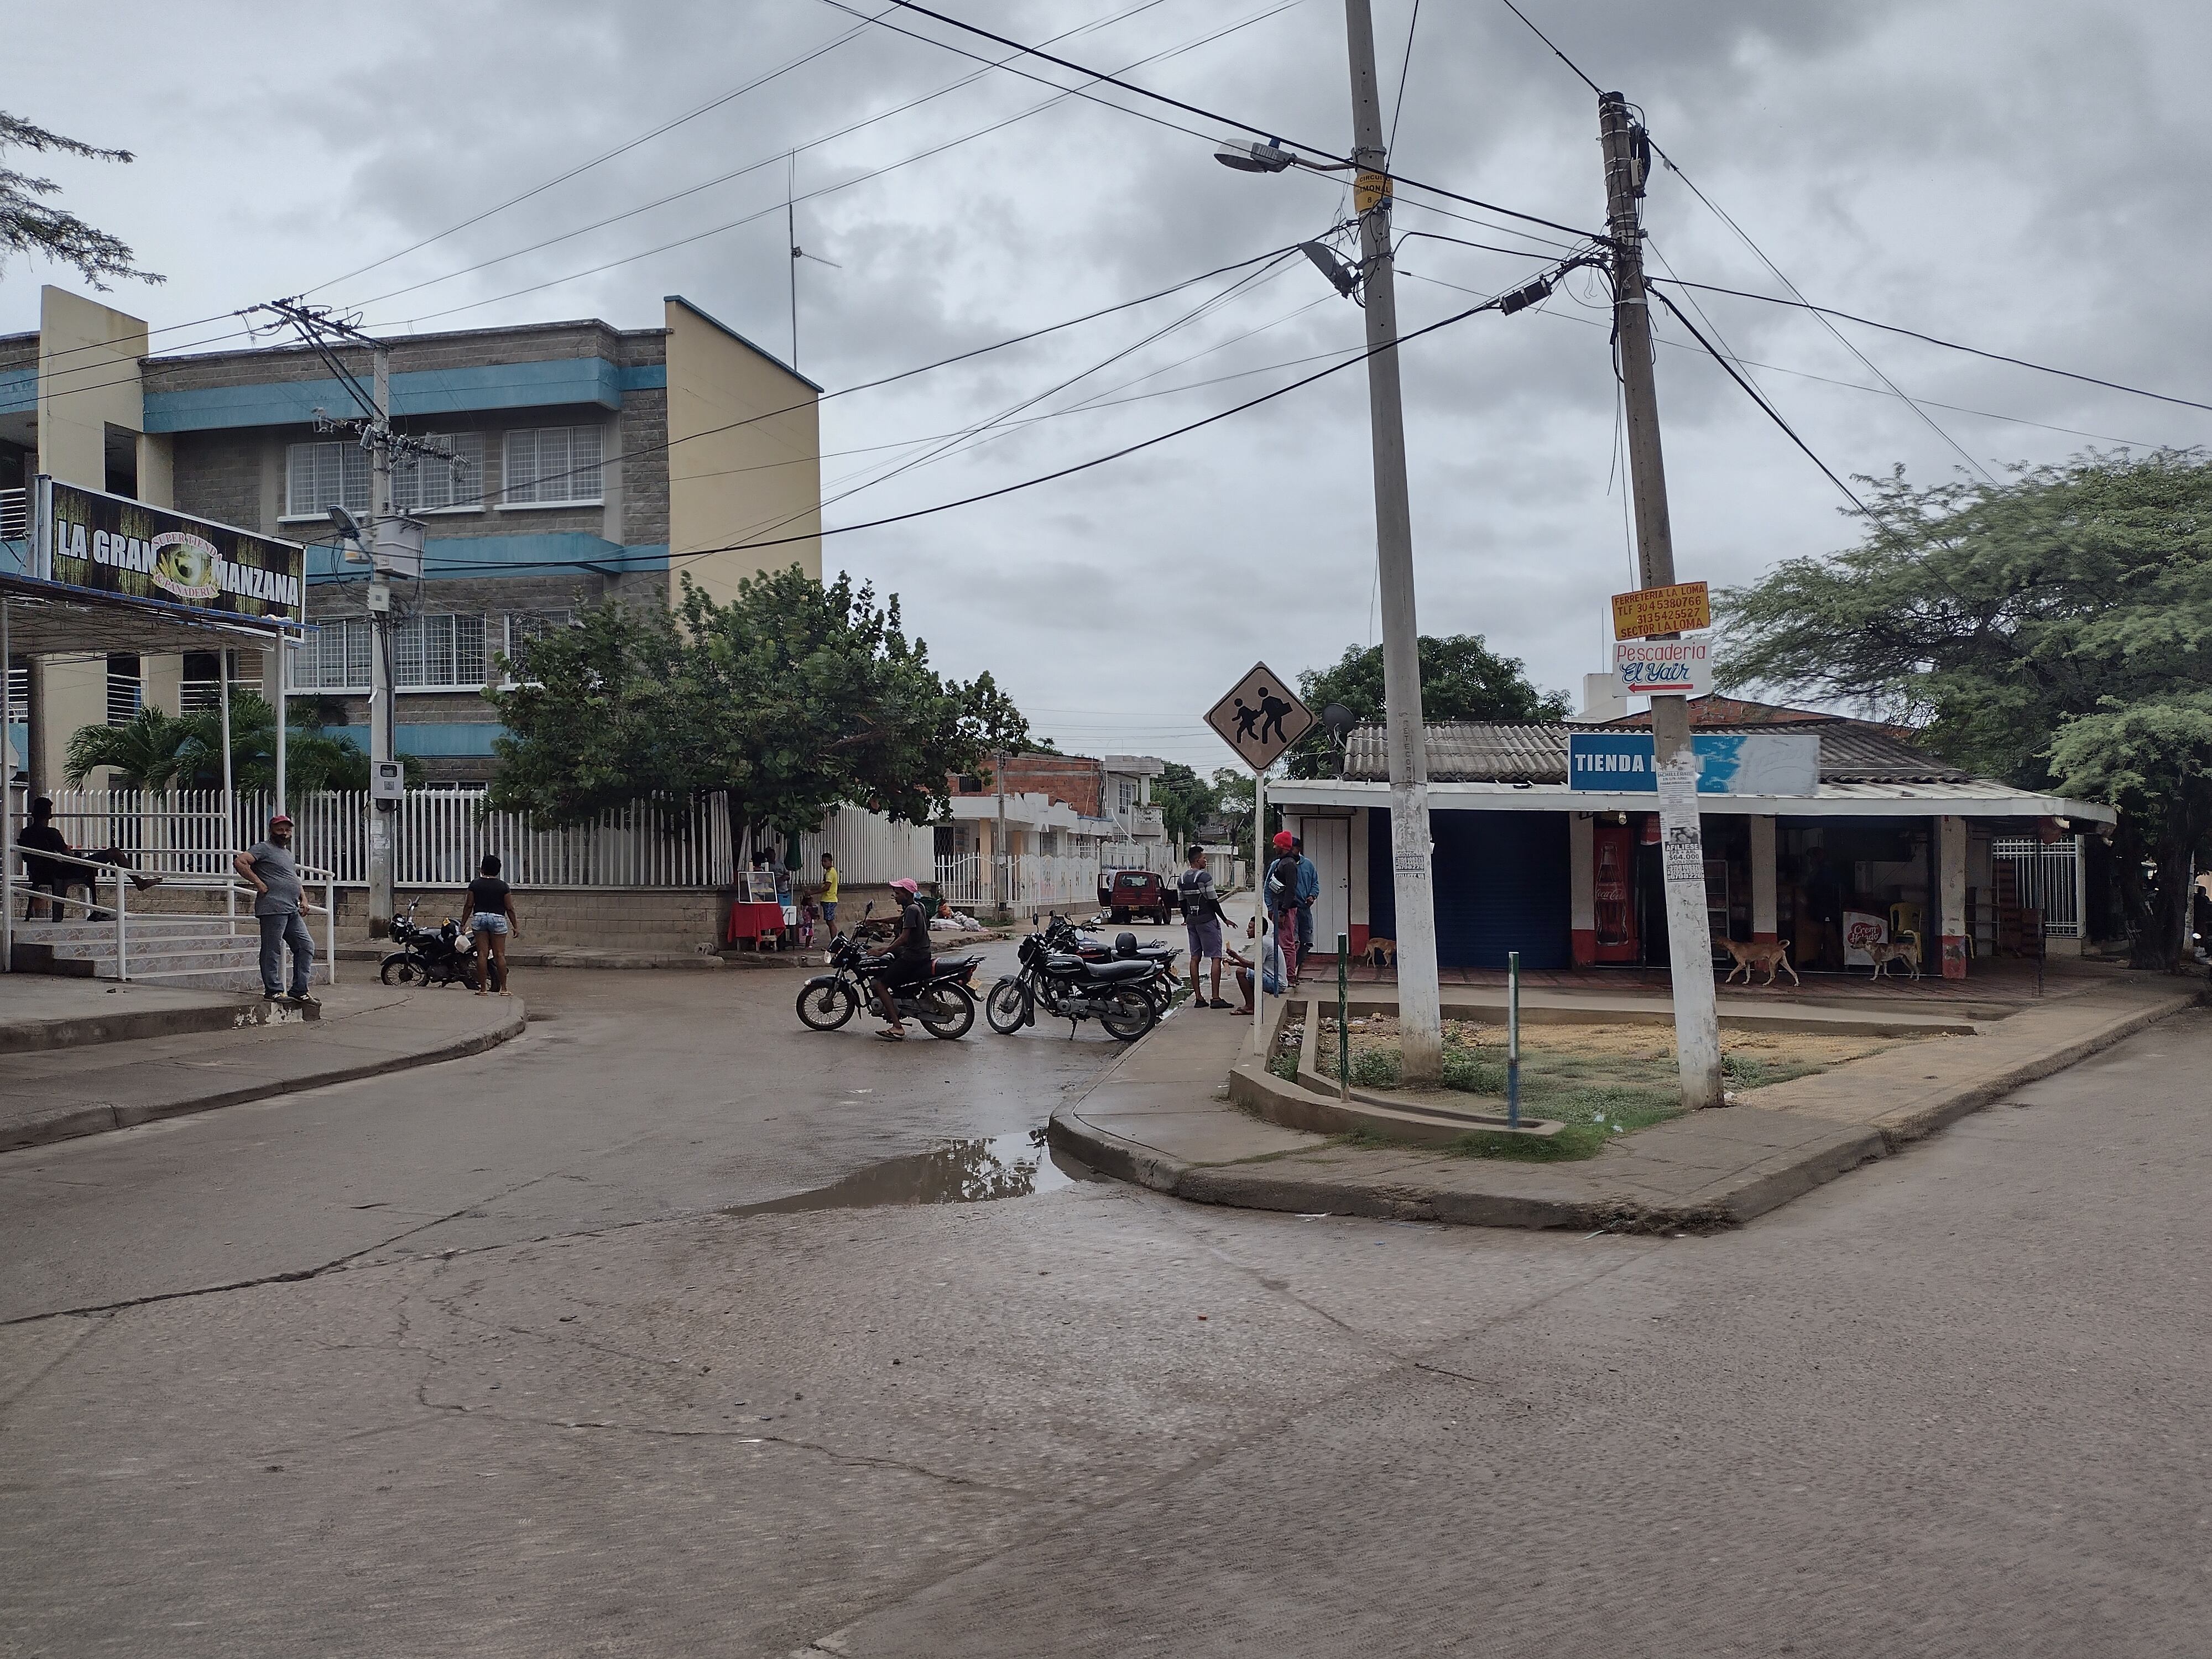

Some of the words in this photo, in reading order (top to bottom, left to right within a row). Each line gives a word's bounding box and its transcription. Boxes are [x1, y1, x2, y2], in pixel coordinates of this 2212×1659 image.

[1356, 185, 1390, 194] AMONAL
[152, 533, 186, 547] SUPER
[187, 535, 222, 562] TIENDA
[58, 520, 88, 560] LA
[93, 529, 158, 575] GRAN
[211, 557, 300, 607] MANZANA
[1615, 591, 1663, 606] FERRETERIA
[1667, 588, 1677, 597] LA
[1681, 585, 1704, 596] LOMA
[1618, 605, 1633, 616] TLF
[1621, 623, 1655, 638] SECTOR
[1658, 622, 1672, 632] LA
[1674, 618, 1704, 630] LOMA
[1617, 641, 1705, 662] Pescaderia
[1620, 662, 1644, 684] El
[1645, 662, 1691, 684] Yair
[1575, 754, 1645, 772] TIENDA
[1854, 925, 1876, 934] Crem
